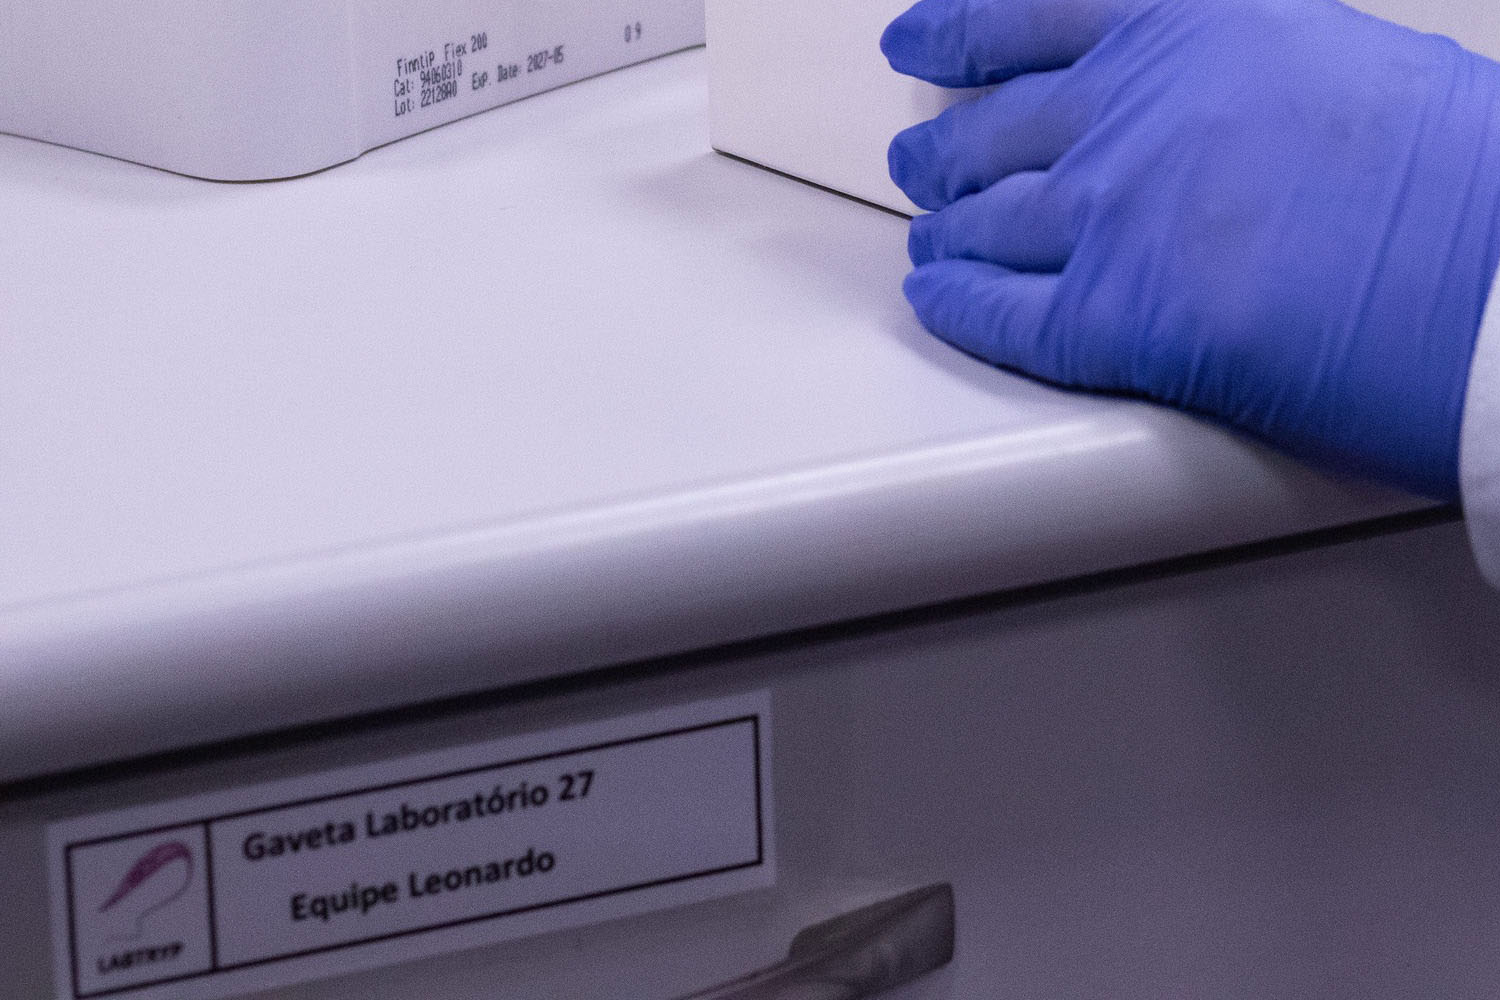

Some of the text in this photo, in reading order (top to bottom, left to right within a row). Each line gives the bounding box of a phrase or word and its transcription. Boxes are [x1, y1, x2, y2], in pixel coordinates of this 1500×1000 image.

[394, 59, 463, 98] Cat: 94060310
[471, 31, 488, 53] 200
[394, 98, 415, 117] Lot:
[527, 44, 564, 73] 2027-05
[243, 770, 595, 862] Gaveta Laboratório 27
[290, 848, 556, 922] Equipe Leonardo
